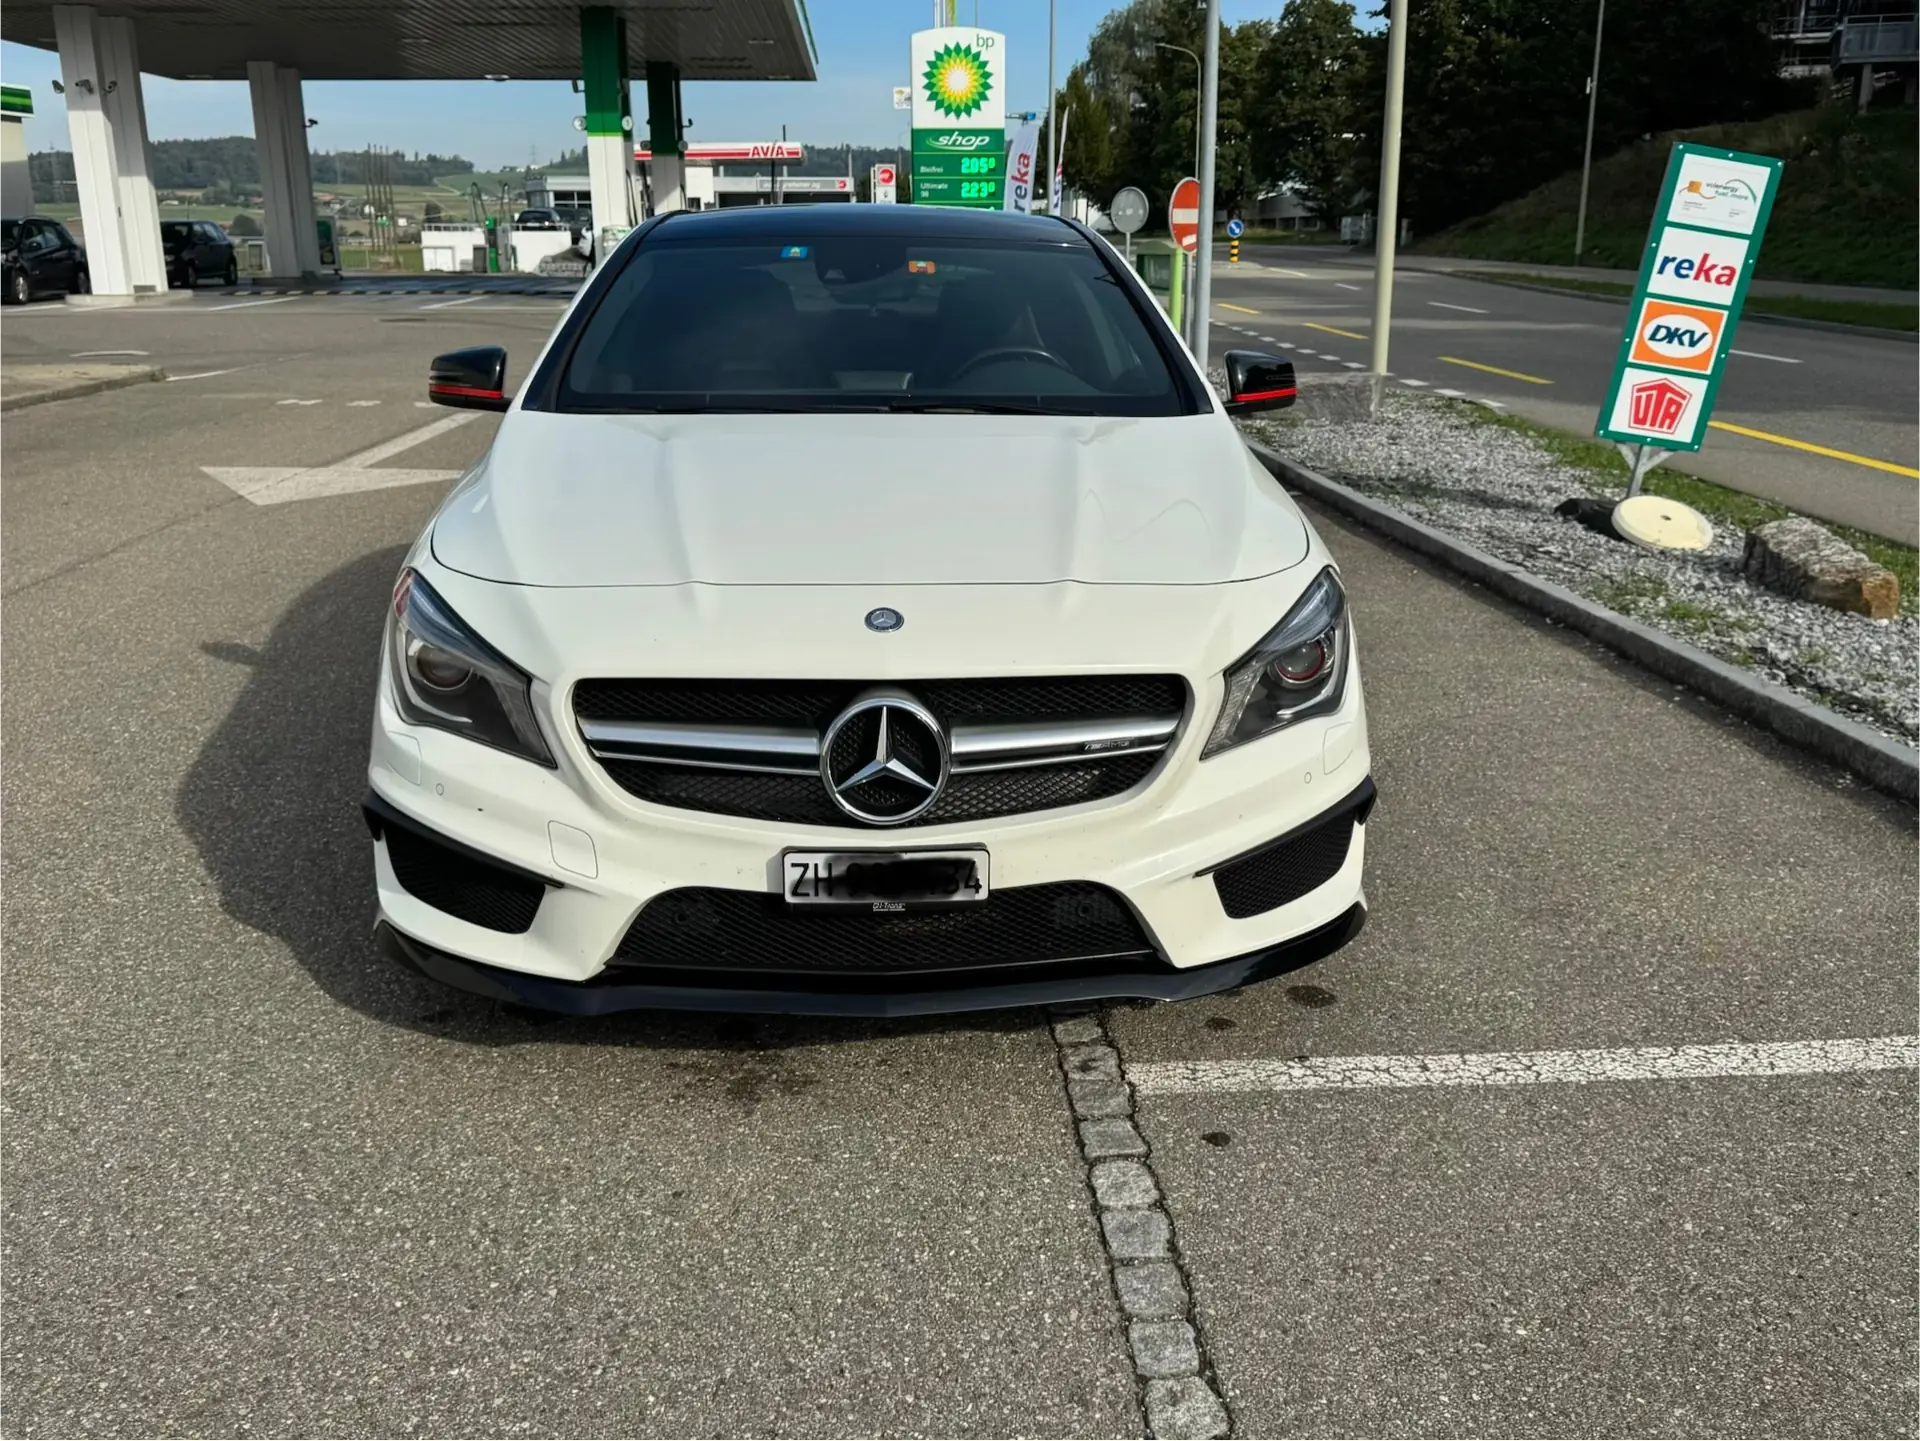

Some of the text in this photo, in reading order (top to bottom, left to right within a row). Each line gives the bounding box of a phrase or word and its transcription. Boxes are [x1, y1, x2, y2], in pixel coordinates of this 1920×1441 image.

[976, 34, 994, 50] bp
[752, 145, 785, 158] AVIA
[936, 131, 990, 148] shop
[1011, 152, 1031, 213] reka
[1656, 253, 1737, 287] reka
[1647, 325, 1709, 348] DKV
[1632, 380, 1689, 430] UTA
[790, 862, 833, 897] ZH
